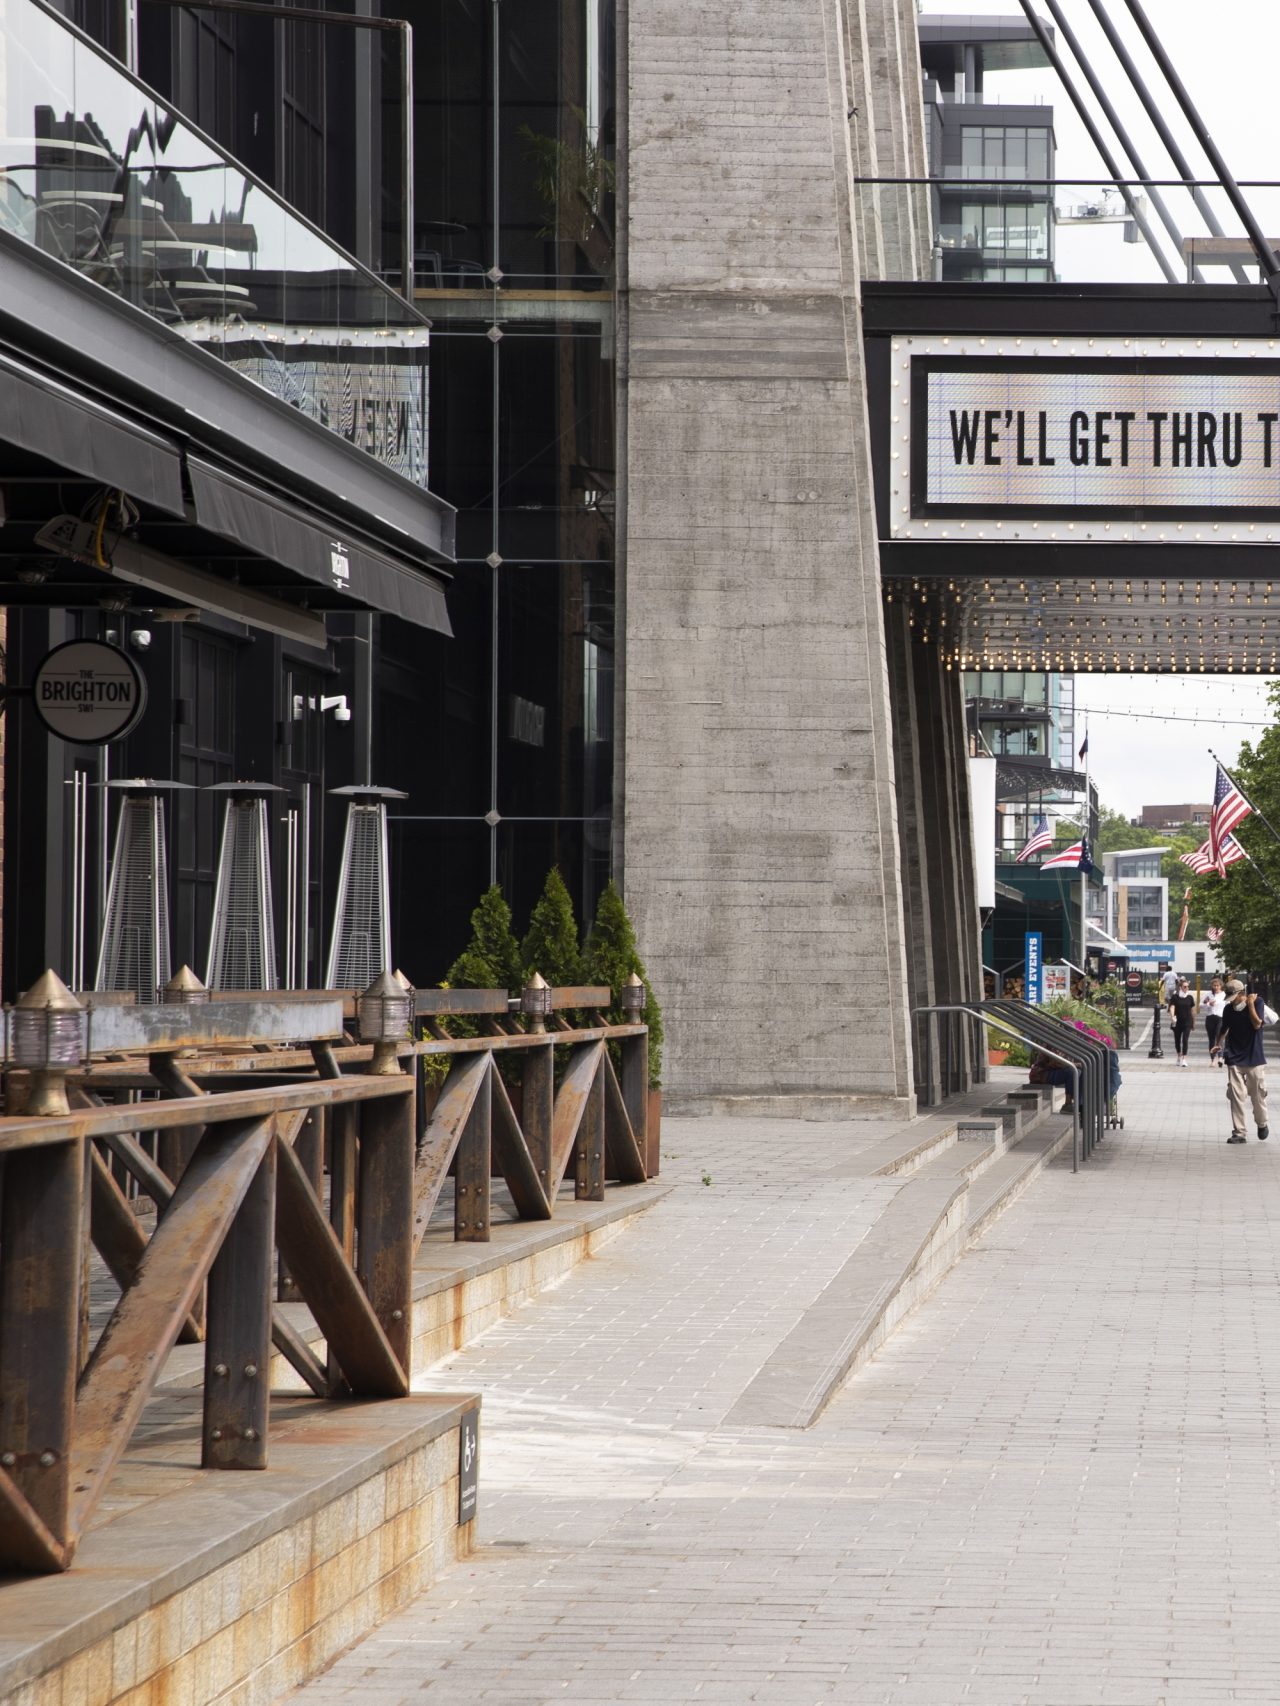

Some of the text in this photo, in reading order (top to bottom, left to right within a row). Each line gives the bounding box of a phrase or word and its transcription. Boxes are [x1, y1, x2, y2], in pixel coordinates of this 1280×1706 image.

[949, 410, 1055, 466] WE'LL
[1069, 410, 1136, 467] GET
[1146, 411, 1242, 468] THRU
[79, 670, 95, 680] THE
[42, 681, 131, 702] BRIGHTON
[1029, 938, 1038, 981] EVENTS
